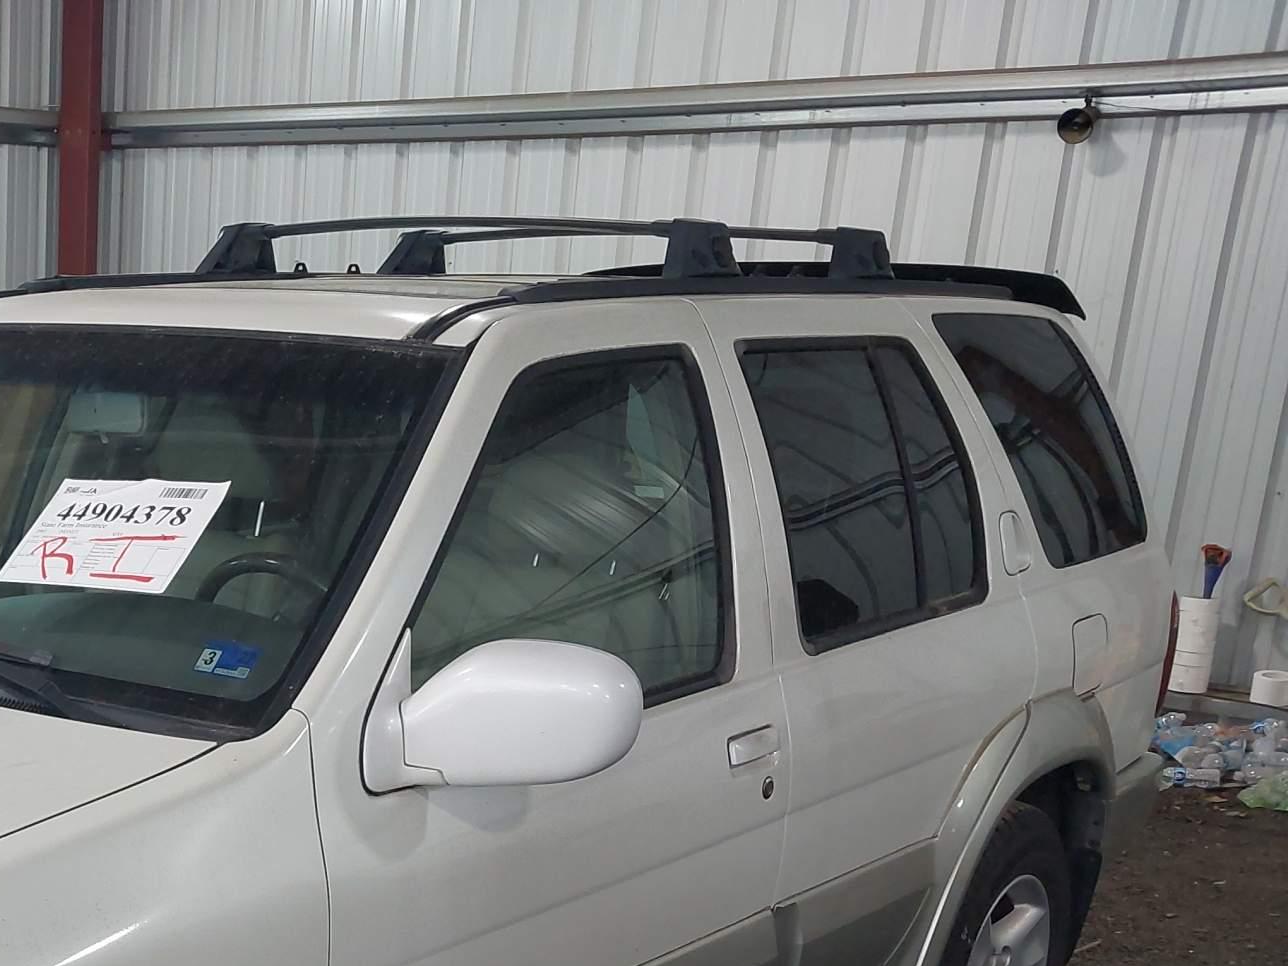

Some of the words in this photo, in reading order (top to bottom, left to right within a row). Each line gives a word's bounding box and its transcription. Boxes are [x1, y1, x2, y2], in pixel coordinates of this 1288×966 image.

[56, 502, 192, 527] 44904378
[30, 535, 74, 581] R
[202, 651, 217, 665] 3
